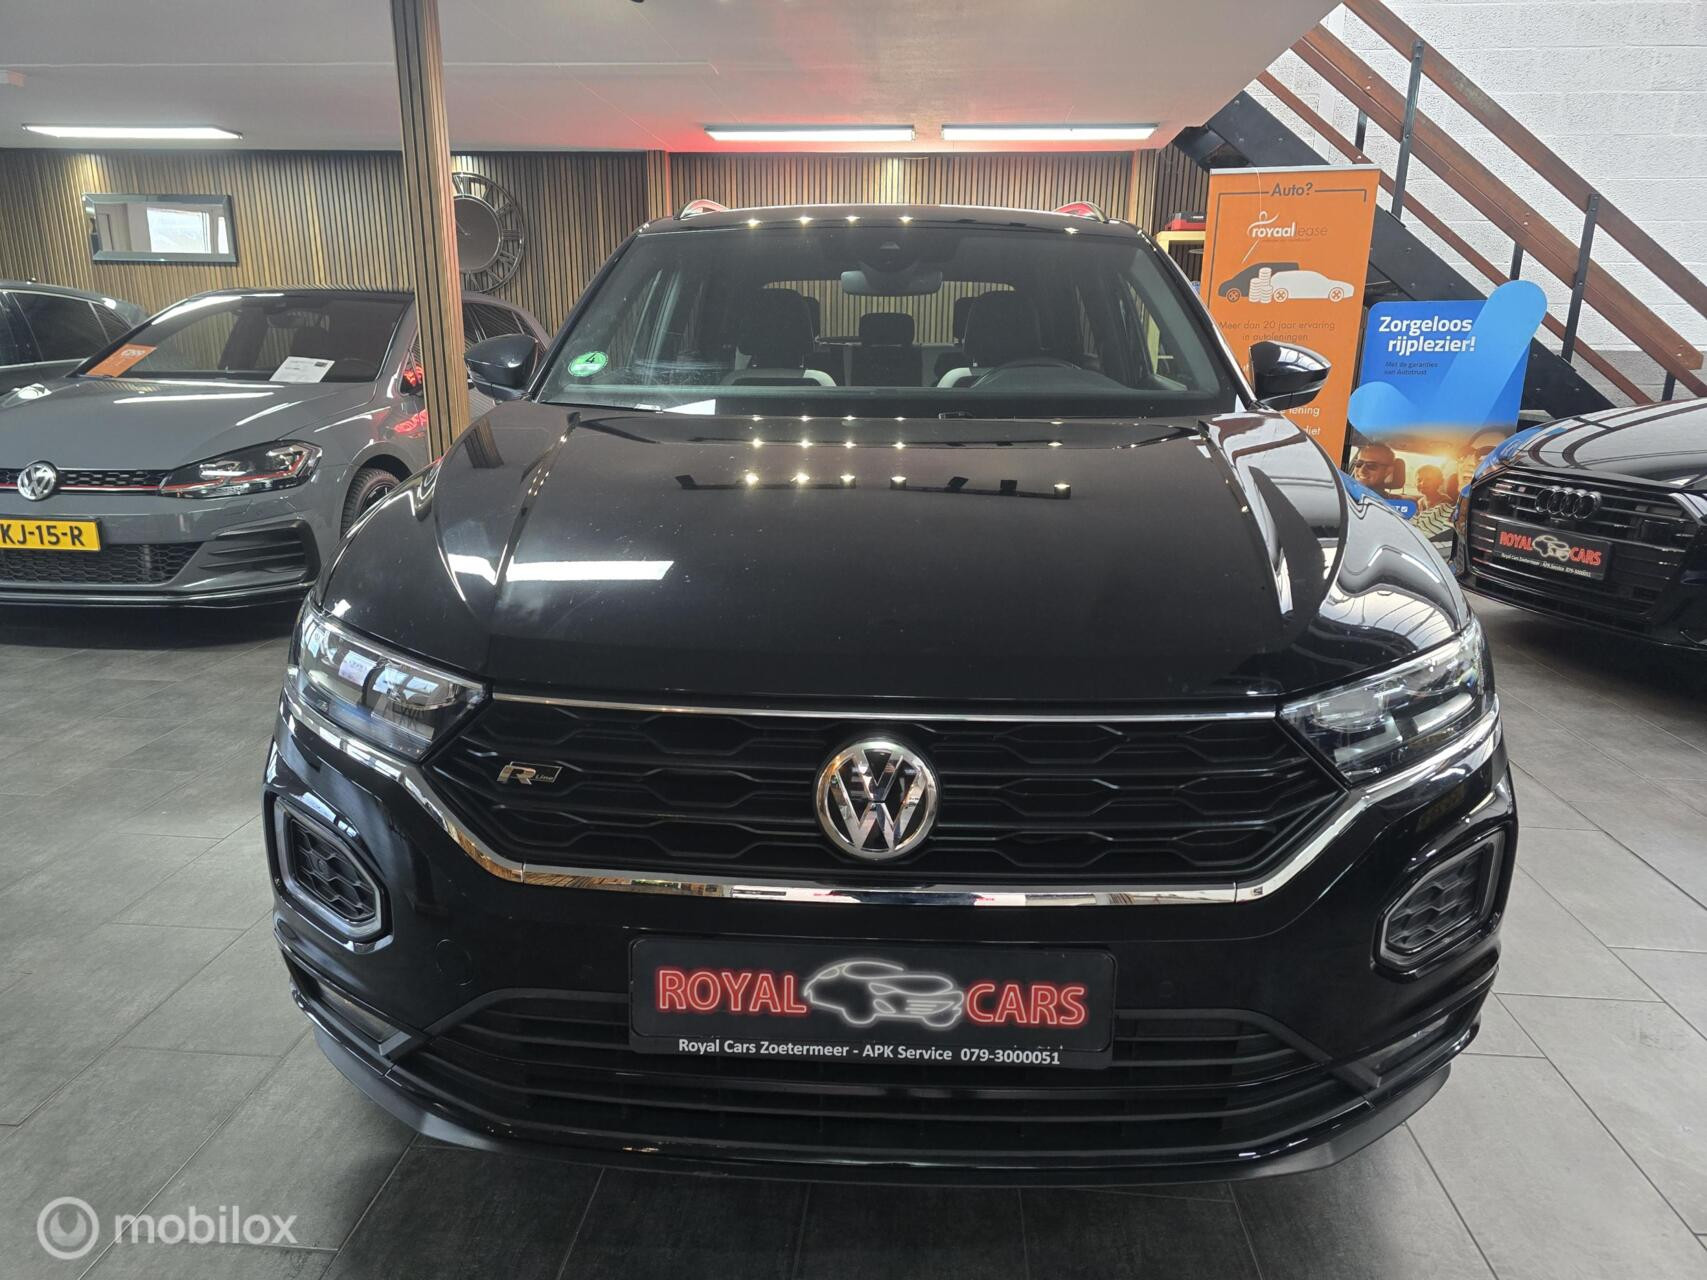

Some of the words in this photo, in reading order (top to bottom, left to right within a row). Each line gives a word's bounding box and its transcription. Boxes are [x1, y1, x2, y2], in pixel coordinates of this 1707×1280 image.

[1270, 182, 1313, 197] Auto?
[1220, 320, 1239, 330] Meer
[1243, 319, 1260, 330] dan
[1263, 319, 1276, 329] 20
[1278, 319, 1297, 332] jaar
[1299, 320, 1336, 332] ervaring
[1379, 315, 1473, 336] Zorgeloos
[1387, 336, 1477, 357] rijplezier!
[1499, 531, 1534, 552] ROYAL
[1569, 546, 1602, 567] CARS
[658, 970, 807, 1014] ROYAL
[966, 982, 1087, 1025] CARS
[678, 1038, 720, 1055] Royal
[723, 1039, 756, 1055] Cars
[759, 1040, 849, 1058] Zoetermeer
[863, 1044, 893, 1058] APK
[897, 1045, 952, 1061] Service
[960, 1047, 1060, 1065] 079-3000051
